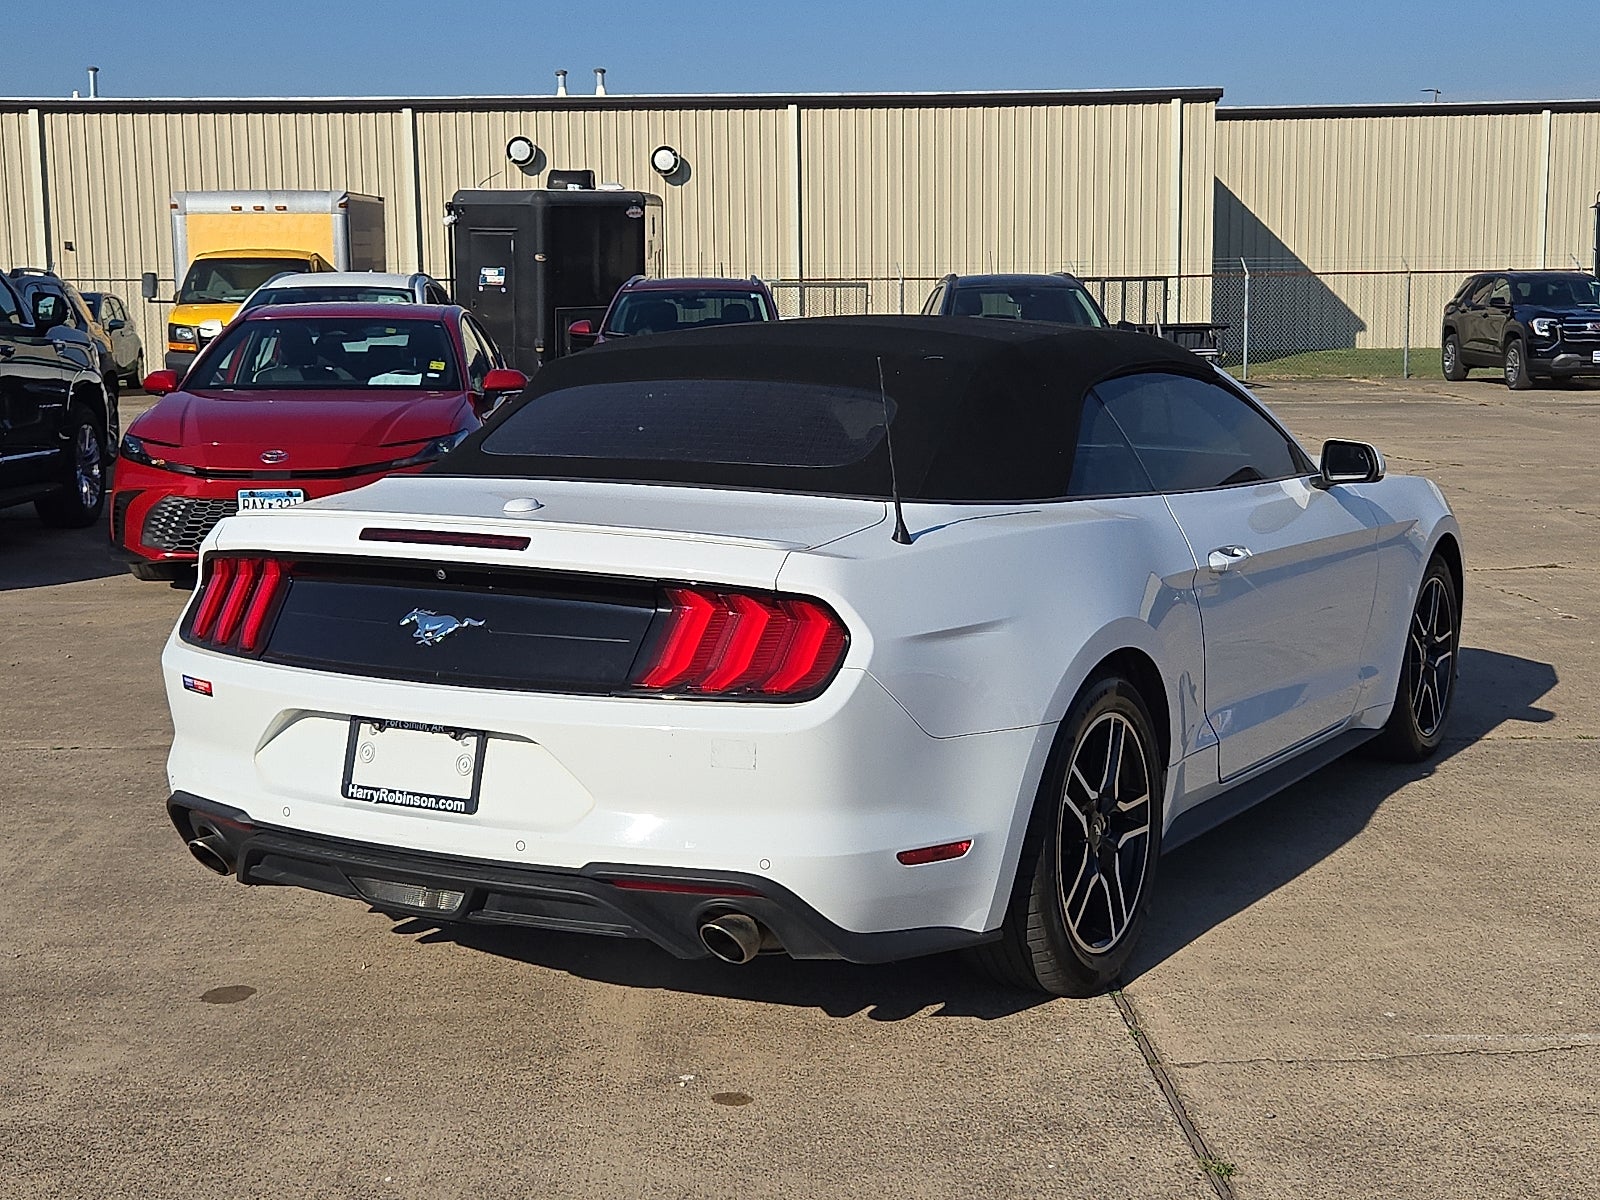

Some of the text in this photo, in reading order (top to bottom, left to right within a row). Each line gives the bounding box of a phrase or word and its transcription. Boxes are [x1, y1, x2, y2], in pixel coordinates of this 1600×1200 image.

[242, 498, 266, 509] RAX
[385, 719, 444, 732] Fort Smith, AR
[348, 783, 466, 812] HarryRobinson.com
